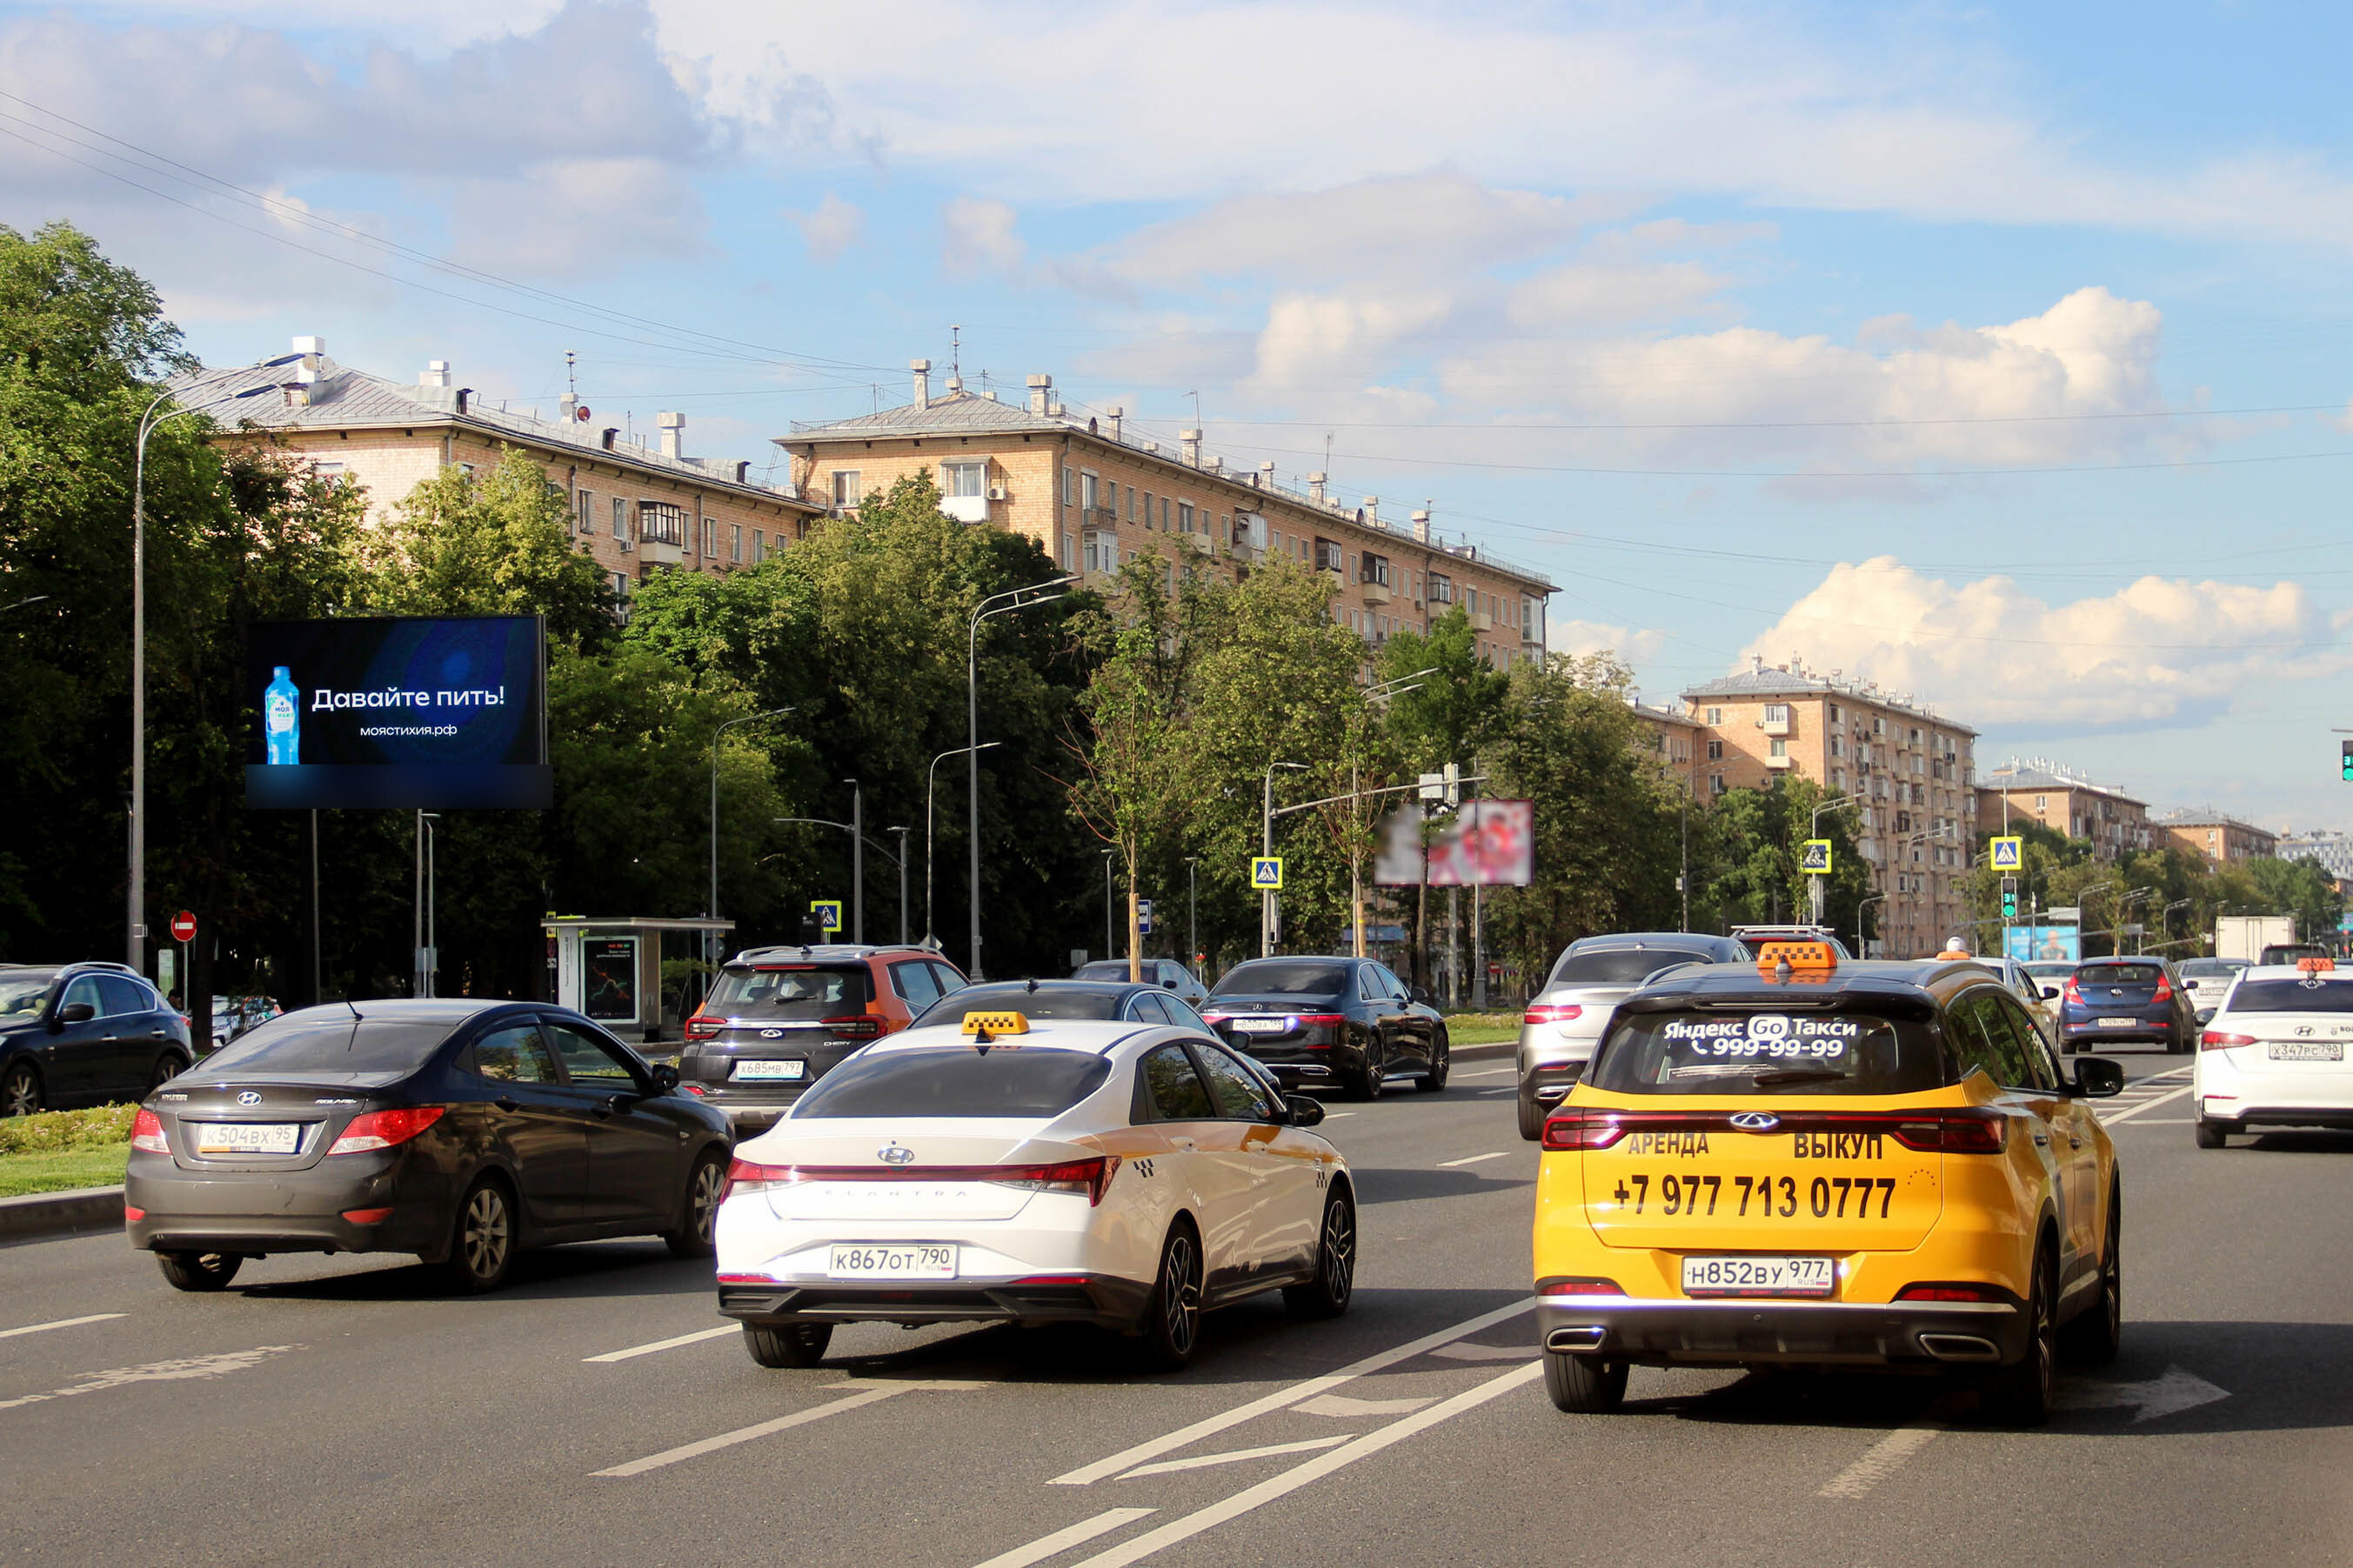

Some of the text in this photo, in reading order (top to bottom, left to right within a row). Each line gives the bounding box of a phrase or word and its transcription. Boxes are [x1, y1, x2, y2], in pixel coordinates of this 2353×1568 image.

[311, 685, 505, 711] Давайте пить!
[360, 724, 458, 737] моястихия.рф
[1663, 1018, 1857, 1039] Яндекс Go Такси
[1713, 1038, 1843, 1057] 999-99-99
[739, 1062, 801, 1074] Х685МВ 797
[206, 1127, 291, 1145] К504ВХ 95
[1628, 1132, 1709, 1158] АРЕНДА
[1794, 1133, 1882, 1159] ВЫКУП
[1614, 1175, 1896, 1218] +7 977 713 0777
[836, 1249, 950, 1270] К867ОТ 790
[1692, 1261, 1825, 1284] Н852ВУ 977
